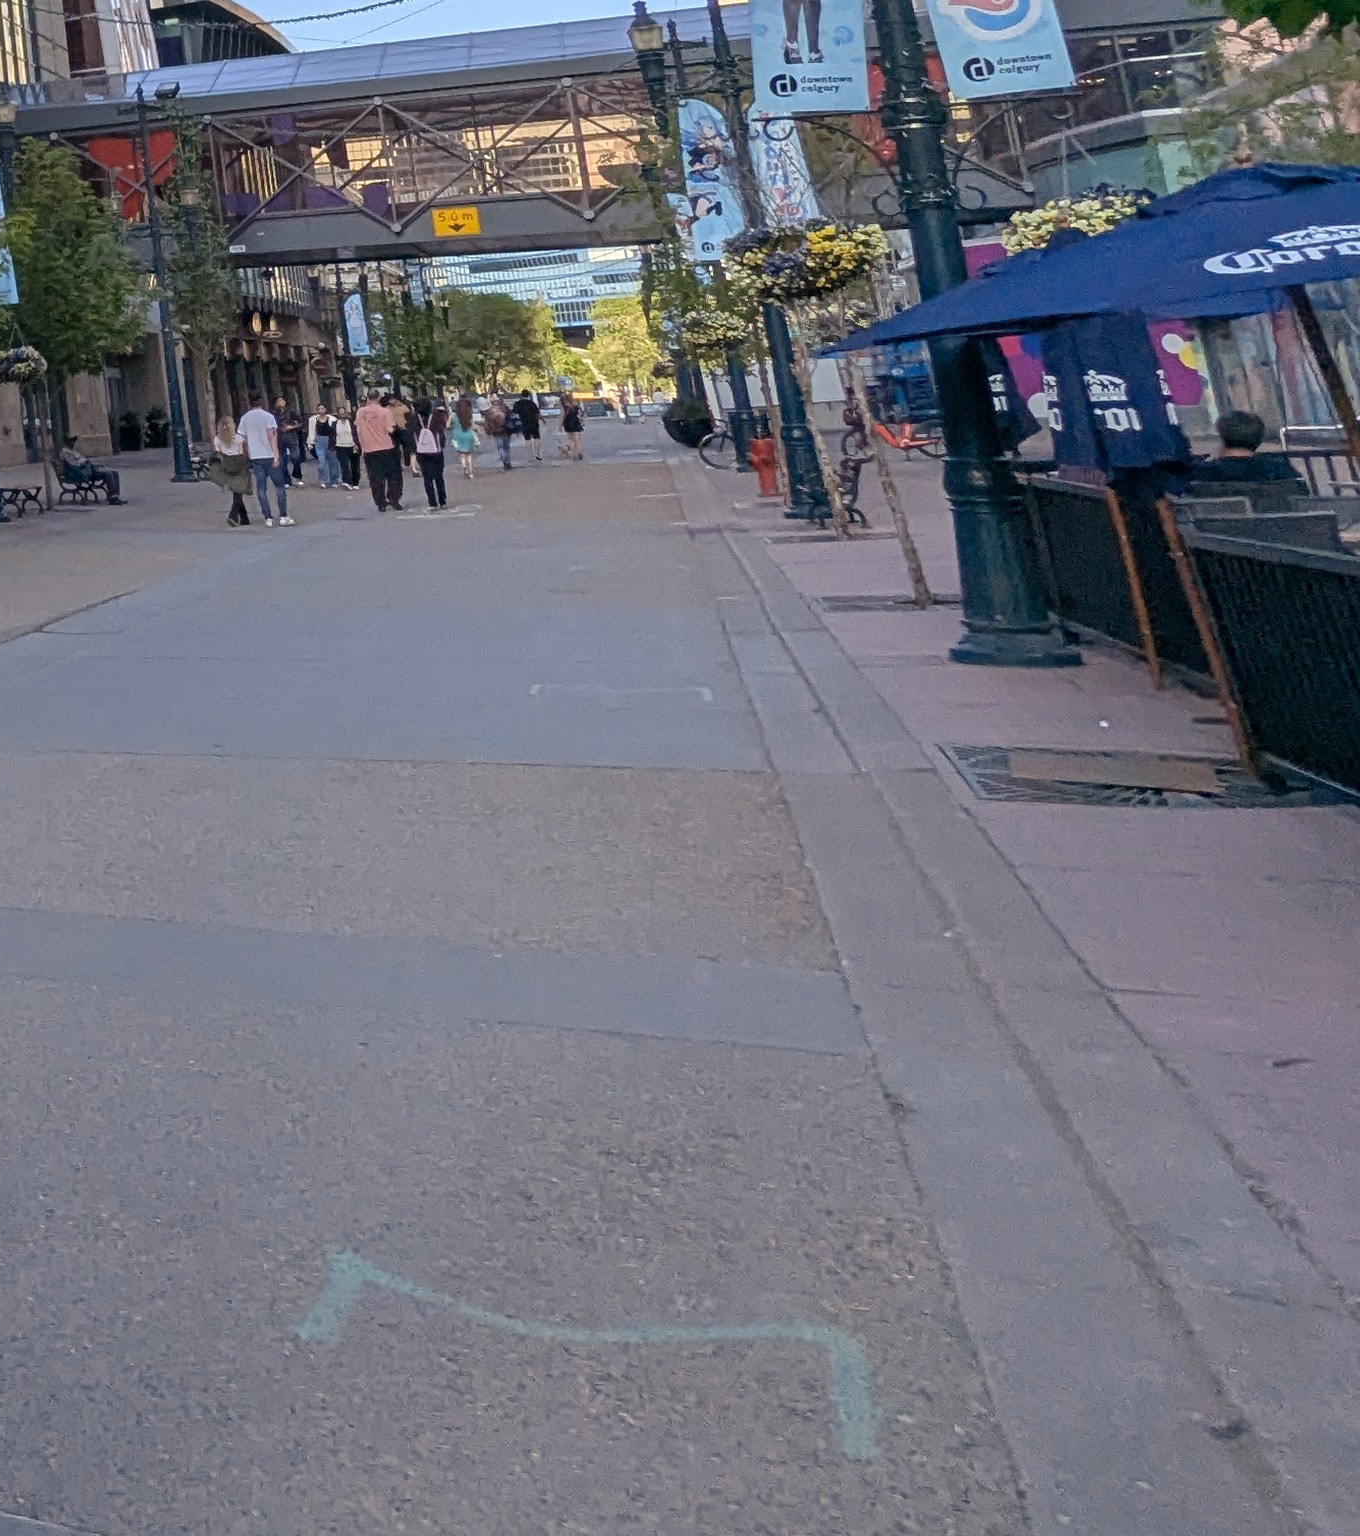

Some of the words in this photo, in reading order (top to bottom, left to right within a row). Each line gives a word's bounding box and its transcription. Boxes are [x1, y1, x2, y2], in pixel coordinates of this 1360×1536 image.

[995, 52, 1053, 68] downtown
[996, 63, 1041, 77] calgary
[799, 74, 853, 85] downtown
[799, 83, 840, 95] calgary
[461, 212, 474, 221] m
